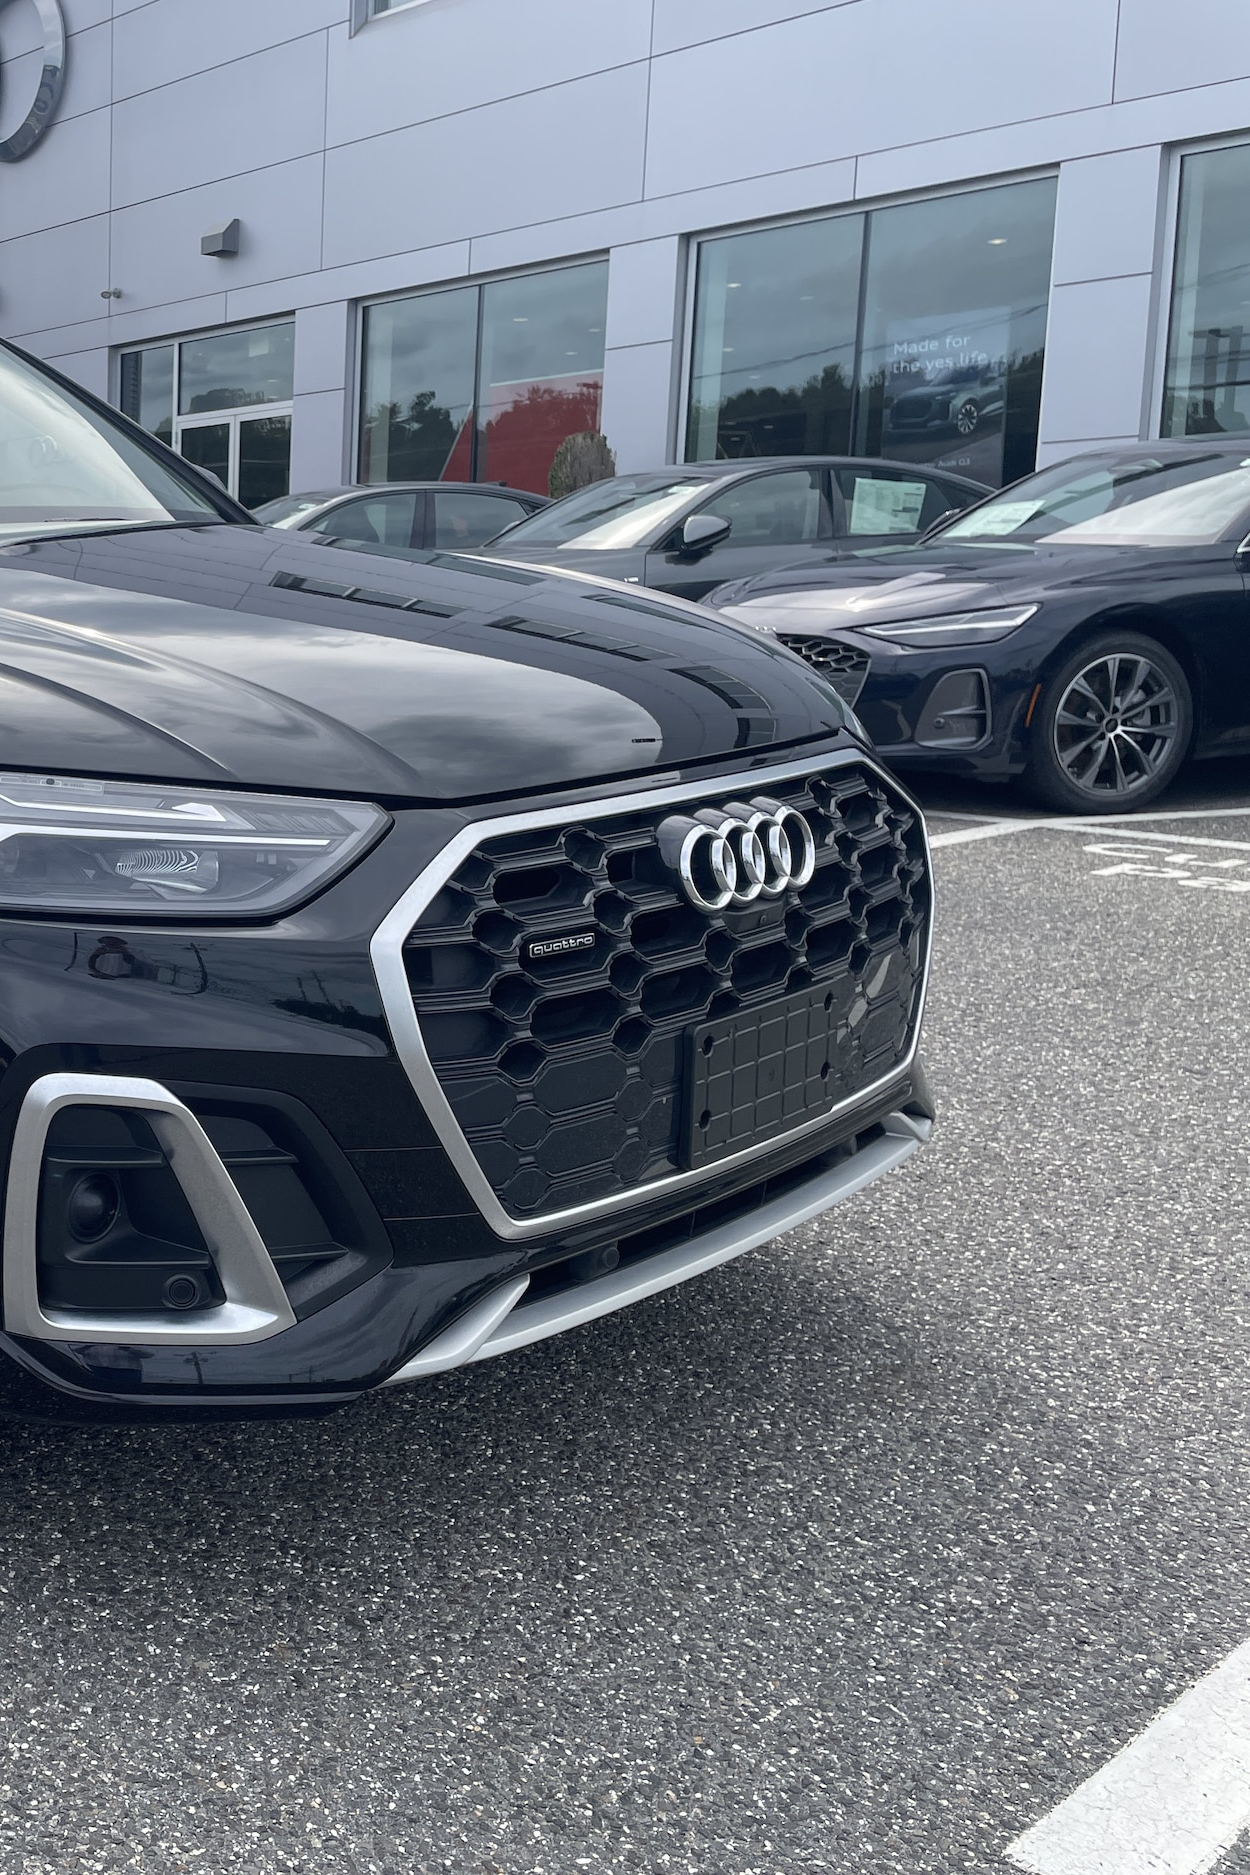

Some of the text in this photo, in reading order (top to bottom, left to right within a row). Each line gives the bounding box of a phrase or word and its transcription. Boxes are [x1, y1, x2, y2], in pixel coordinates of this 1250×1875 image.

[893, 335, 971, 356] Made for
[892, 351, 989, 374] the yes life
[532, 936, 593, 955] quattro
